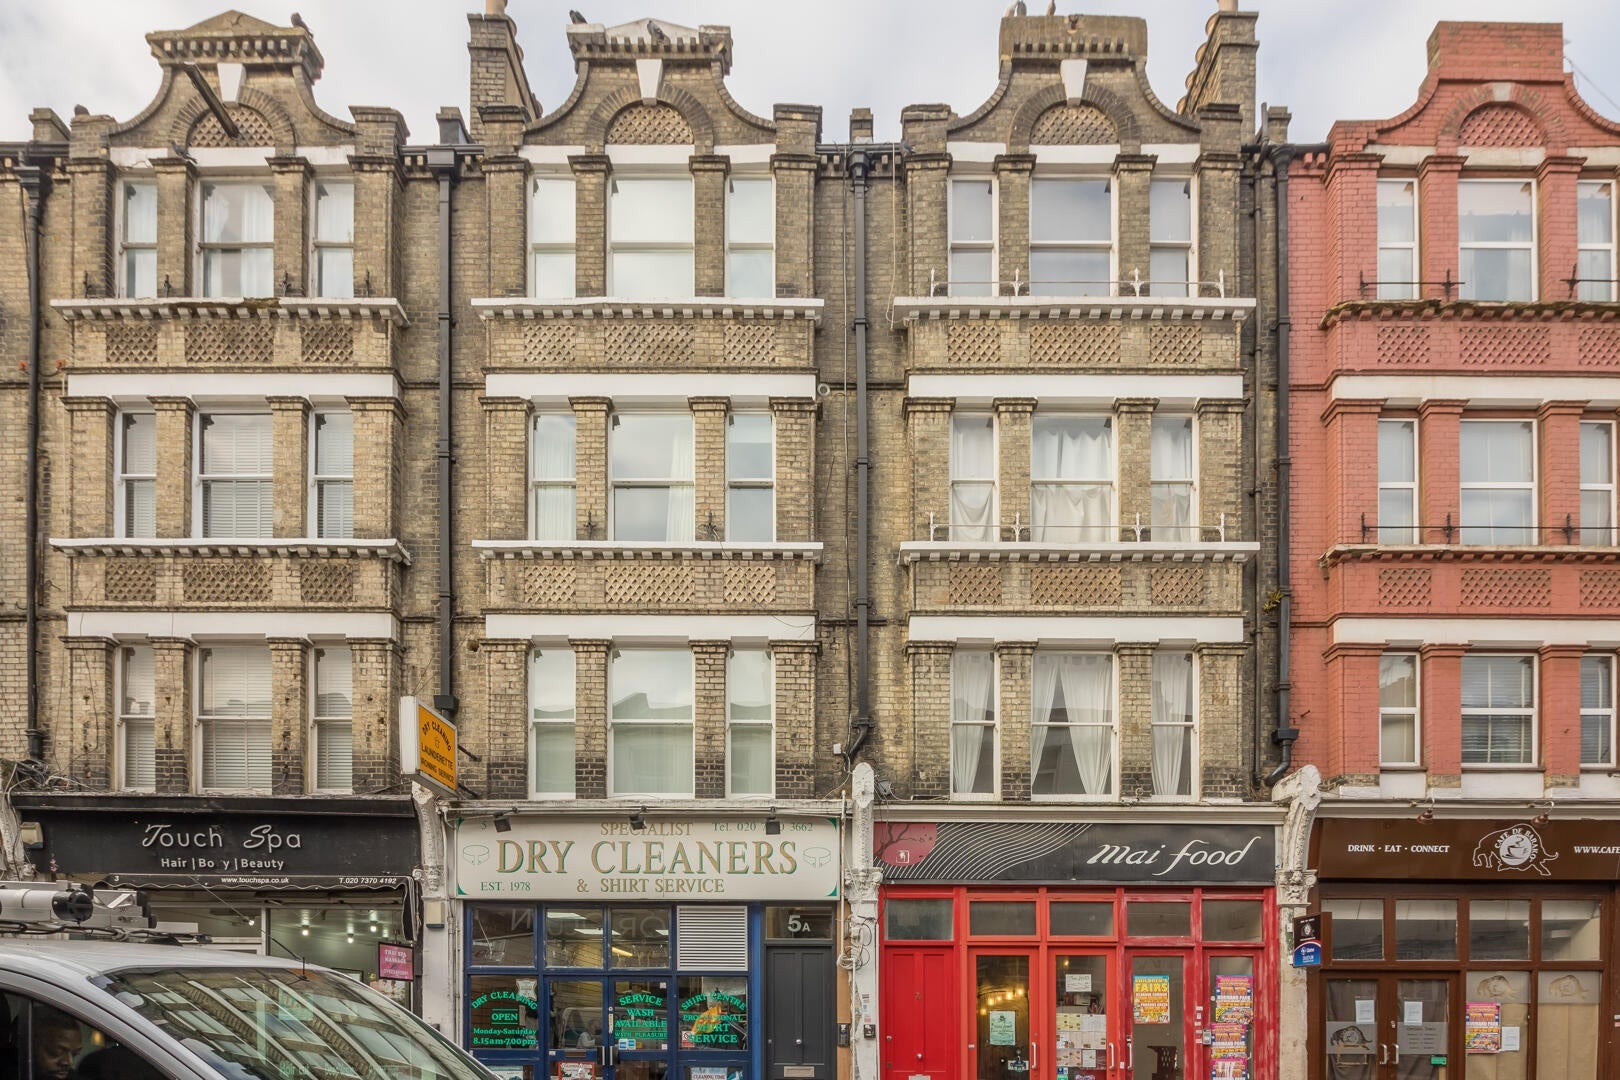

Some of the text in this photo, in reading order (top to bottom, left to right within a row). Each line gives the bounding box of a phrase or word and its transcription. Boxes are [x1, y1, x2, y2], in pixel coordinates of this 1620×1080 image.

[422, 721, 451, 751] DRY CLEANING
[421, 743, 454, 771] LAUNDERETTE
[438, 767, 455, 785] SERVICE
[736, 822, 757, 832] 020
[790, 822, 814, 832] 3662
[142, 824, 302, 853] Touch Spa
[1347, 844, 1451, 853] DRINK EAT CONNECT
[496, 839, 798, 875] DRY CLEANERS
[1152, 836, 1262, 876] food
[161, 858, 188, 868] Hair
[241, 858, 284, 871] Beauty
[221, 876, 290, 885] www.touchspa.co.uk
[480, 881, 531, 892] EST. 1978
[576, 878, 725, 893] & SHIRT SERVICE
[1135, 983, 1169, 993] FAIRS
[471, 990, 538, 1010] DRY CLEANING
[619, 993, 663, 1007] SERVICE
[681, 991, 746, 1011] SHIRT CENTRE
[491, 1013, 519, 1021] OPEN
[627, 1008, 655, 1017] WASH
[614, 1019, 668, 1028] AVAILABLE
[473, 1027, 537, 1036] Monday-Saturday
[688, 1034, 739, 1043] SERVICE
